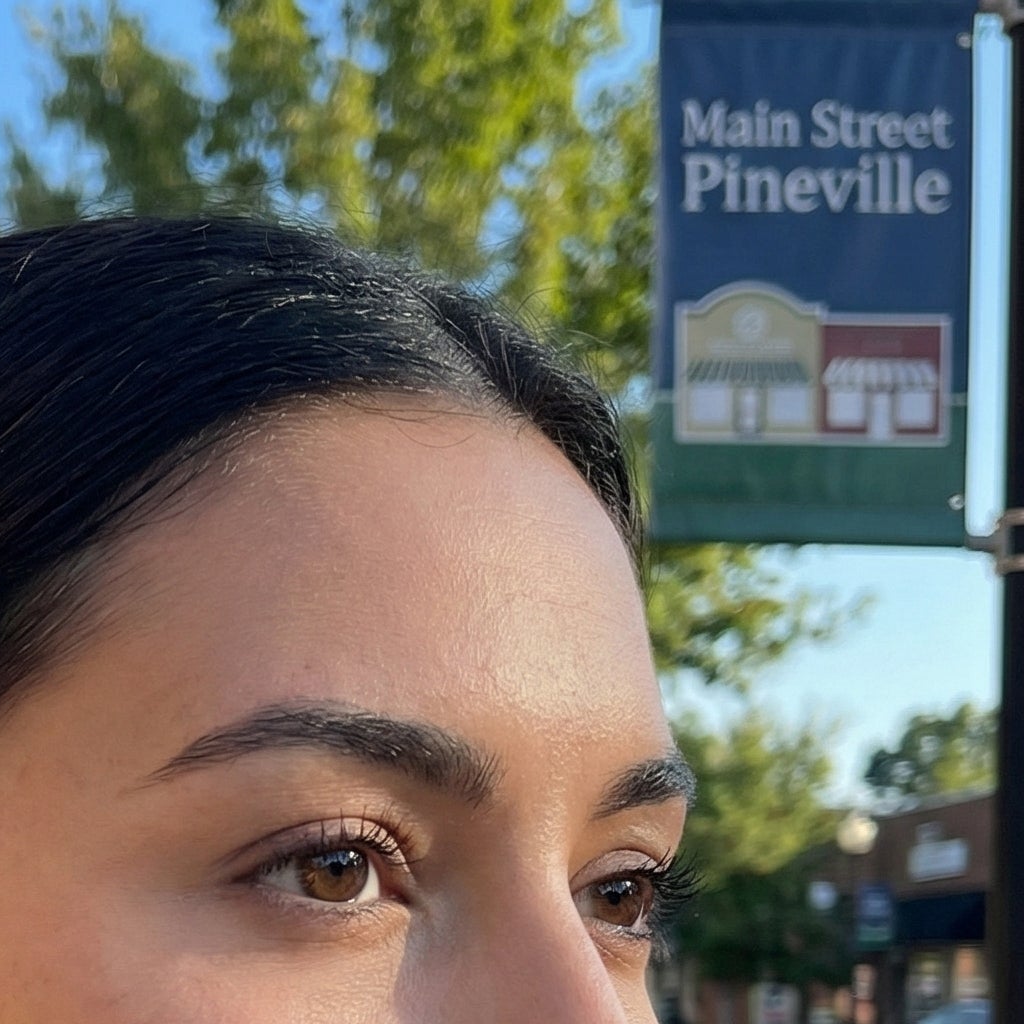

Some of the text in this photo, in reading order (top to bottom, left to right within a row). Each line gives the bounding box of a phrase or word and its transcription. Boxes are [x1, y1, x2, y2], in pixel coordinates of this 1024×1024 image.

[682, 99, 955, 149] Main Street
[682, 153, 952, 214] Pineville
